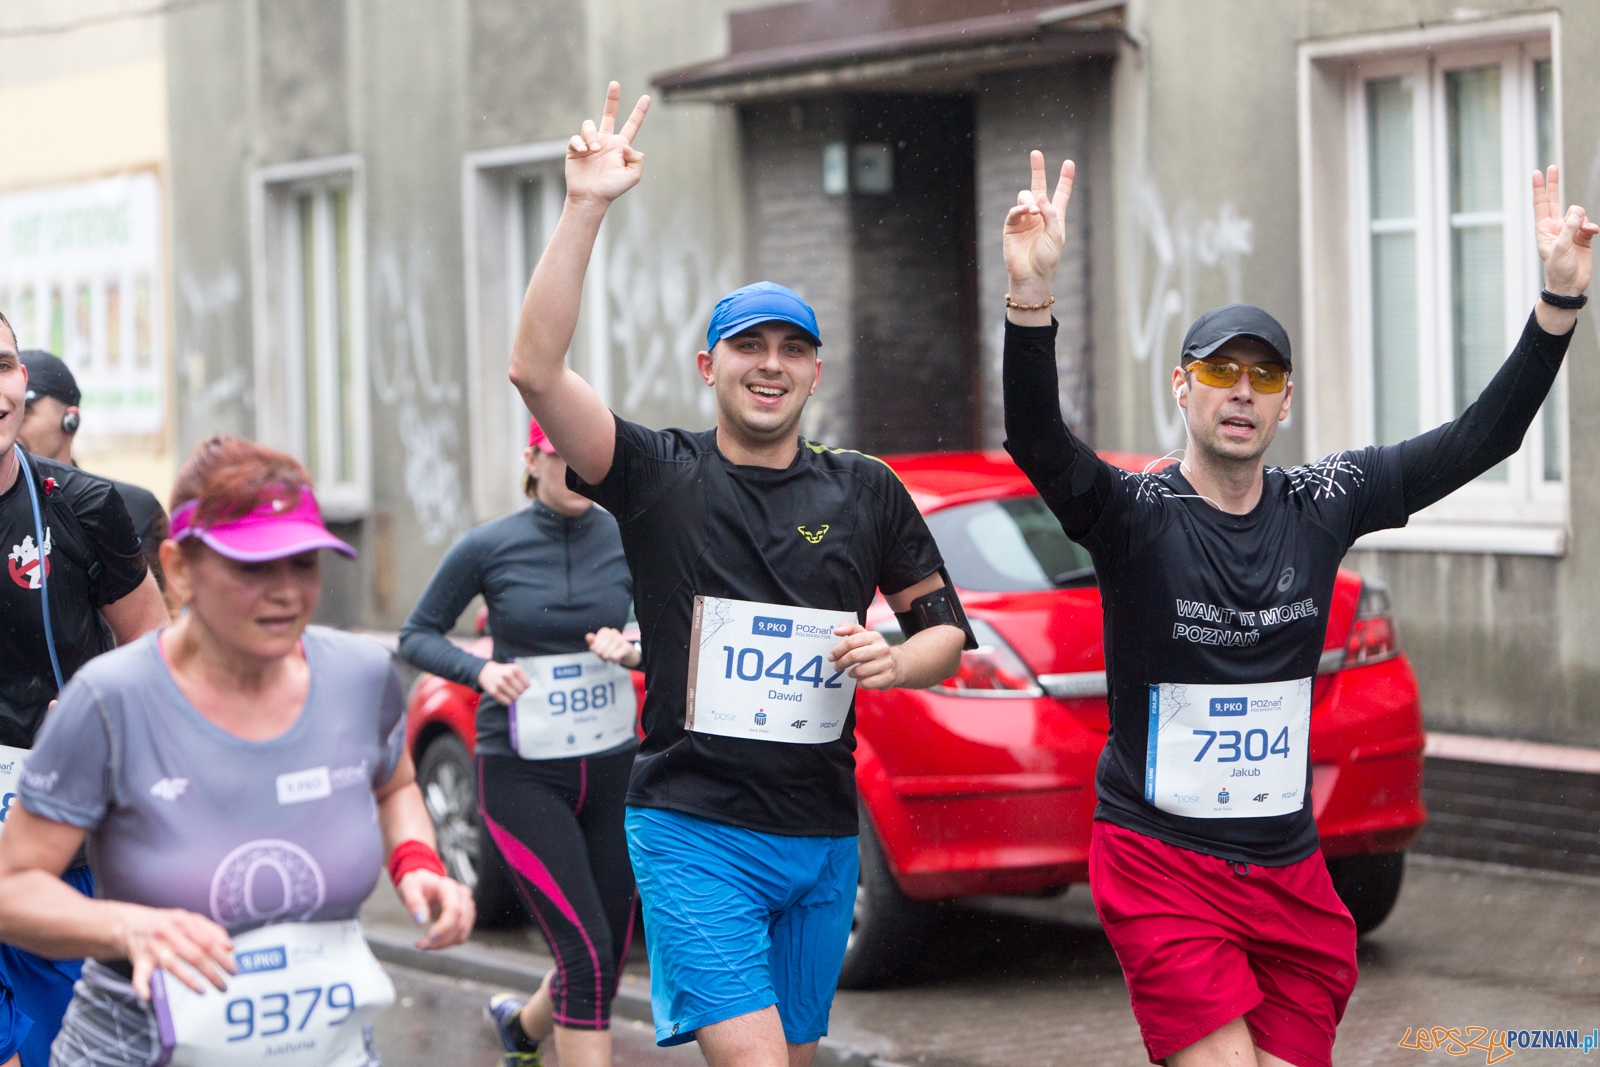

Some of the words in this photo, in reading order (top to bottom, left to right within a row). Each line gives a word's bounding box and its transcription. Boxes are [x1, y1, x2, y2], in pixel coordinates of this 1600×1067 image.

[1176, 598, 1236, 624] WANT
[1240, 611, 1255, 626] IT
[1260, 598, 1319, 625] MORE,
[758, 621, 766, 631] 9.
[767, 622, 787, 633] PKO
[1172, 622, 1260, 647] POZNAŃ
[723, 645, 846, 689] 10442
[548, 681, 616, 715] 9881
[768, 689, 803, 703] Dawid
[1215, 702, 1223, 712] 9.
[1223, 702, 1243, 711] PKO
[790, 719, 808, 729] 4F
[1192, 725, 1290, 763] 7304
[1229, 767, 1261, 778] Jakub
[1252, 792, 1270, 803] 4F
[226, 982, 355, 1043] 9379
